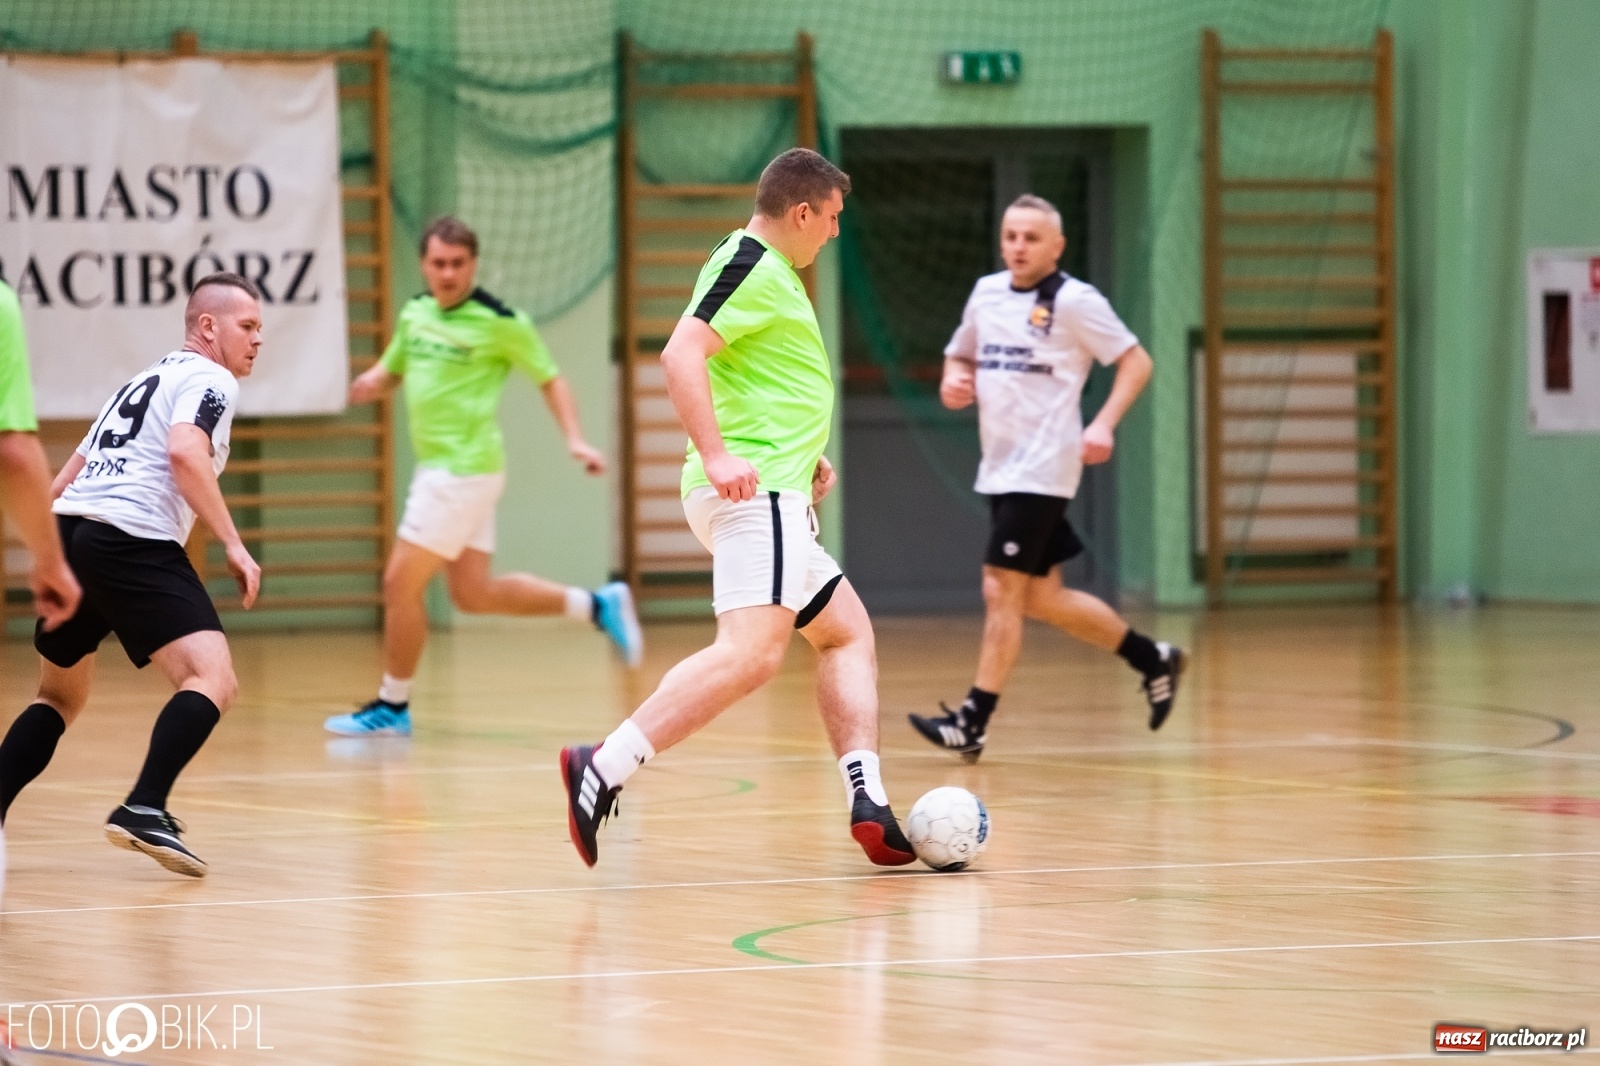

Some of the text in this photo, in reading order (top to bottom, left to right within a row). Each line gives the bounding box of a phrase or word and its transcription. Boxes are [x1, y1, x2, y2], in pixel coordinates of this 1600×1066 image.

[7, 163, 272, 223] MIASTO
[0, 234, 320, 309] ACIBÓRZ
[89, 374, 160, 451] 19
